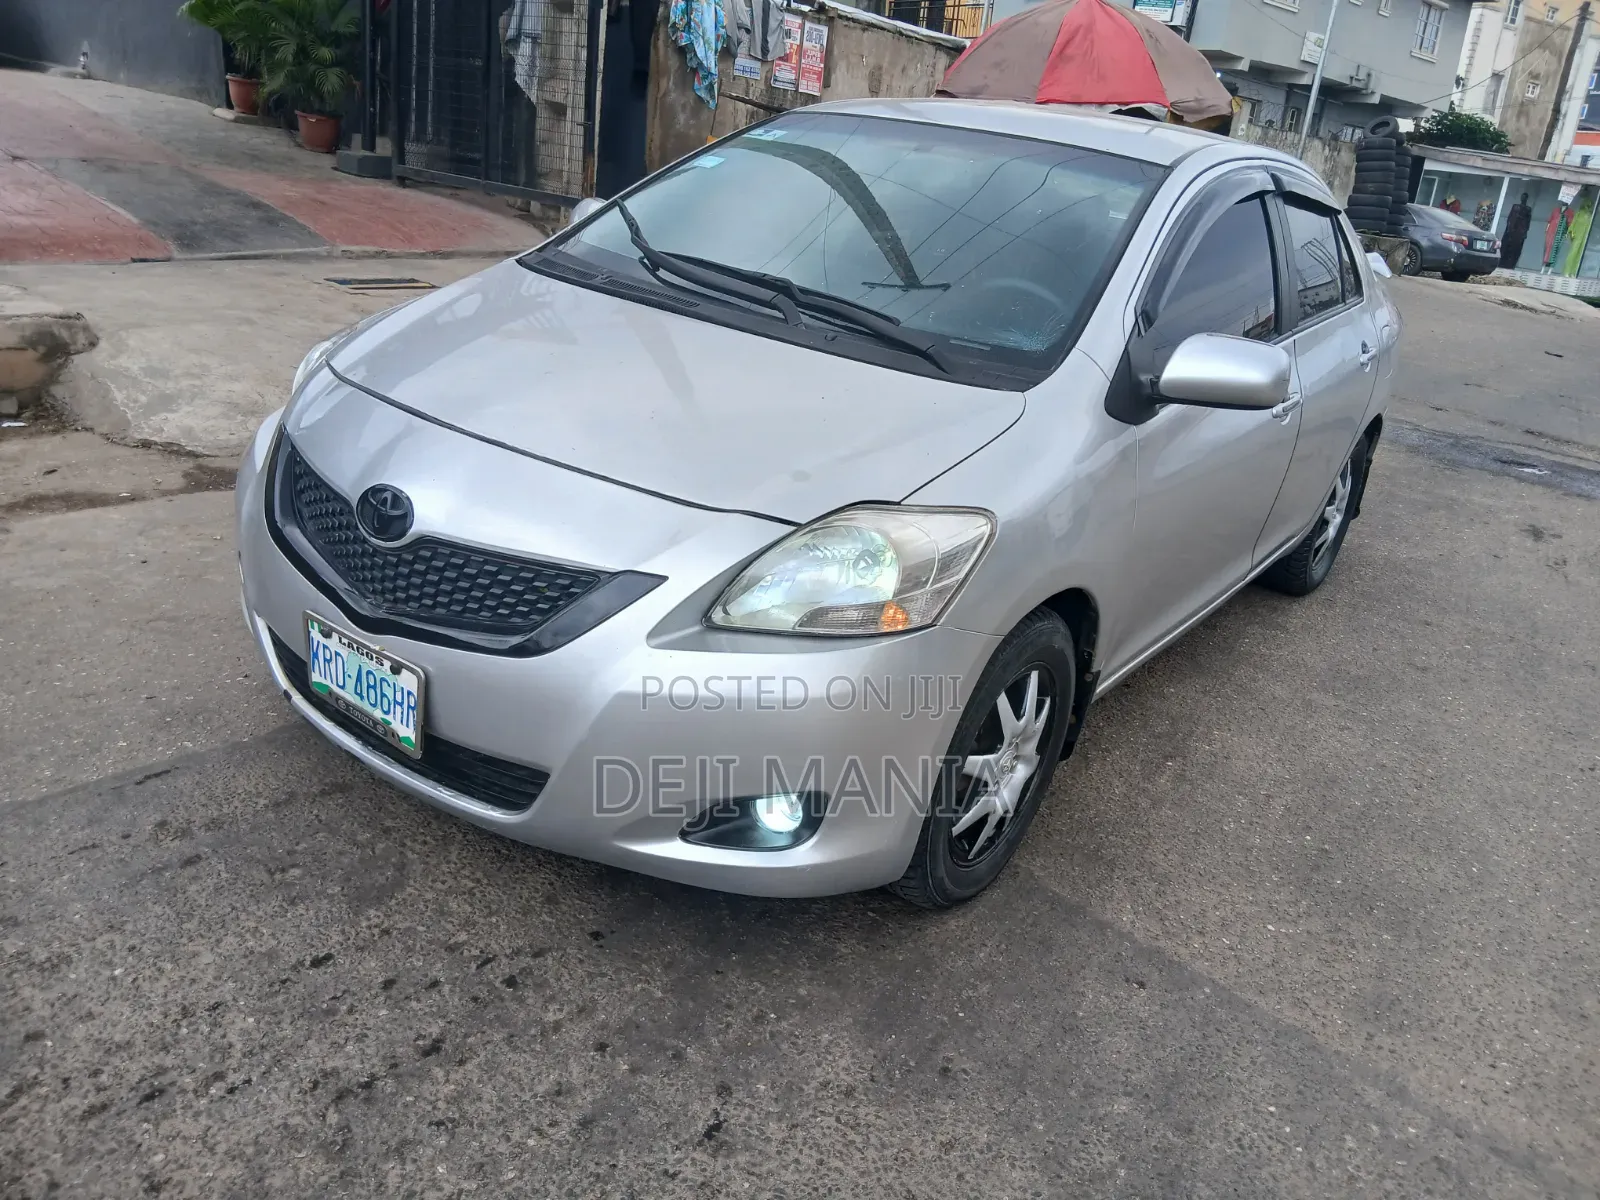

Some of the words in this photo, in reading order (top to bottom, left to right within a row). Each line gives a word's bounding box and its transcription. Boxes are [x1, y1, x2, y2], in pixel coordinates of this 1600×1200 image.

[338, 636, 385, 667] LAGOS
[310, 632, 417, 732] KRD-486HR
[349, 706, 374, 728] TOYOTA
